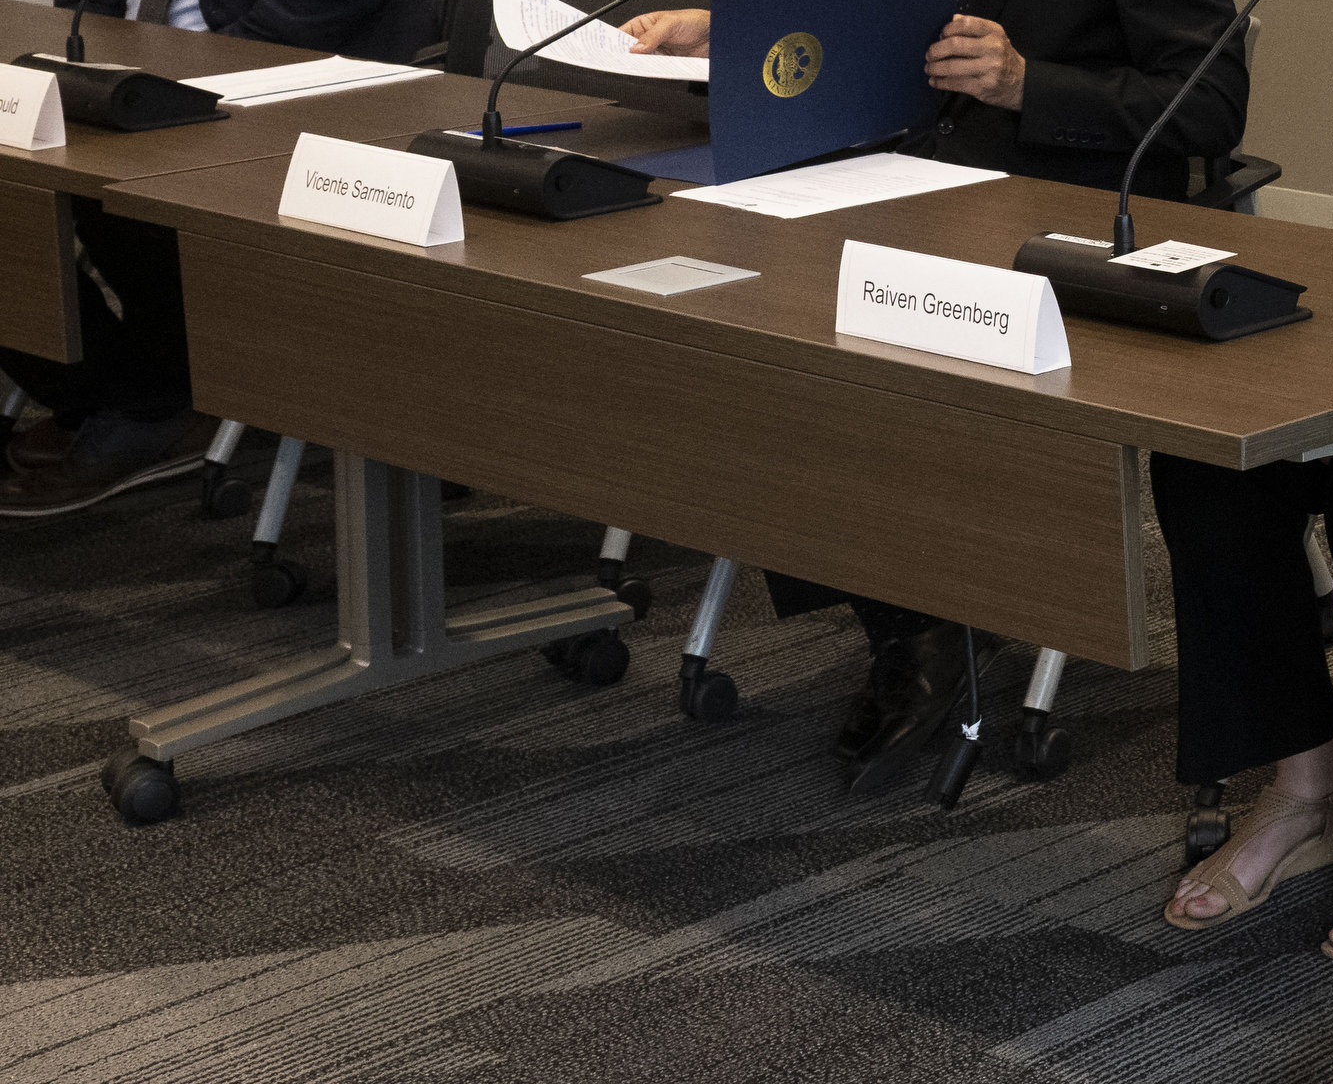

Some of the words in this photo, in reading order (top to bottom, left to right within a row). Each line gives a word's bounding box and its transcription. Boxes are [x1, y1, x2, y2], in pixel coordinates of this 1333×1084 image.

[305, 169, 349, 198] Vicente
[351, 179, 415, 211] Sarmiento
[862, 280, 918, 313] Raiven
[922, 292, 1011, 335] Greenberg
